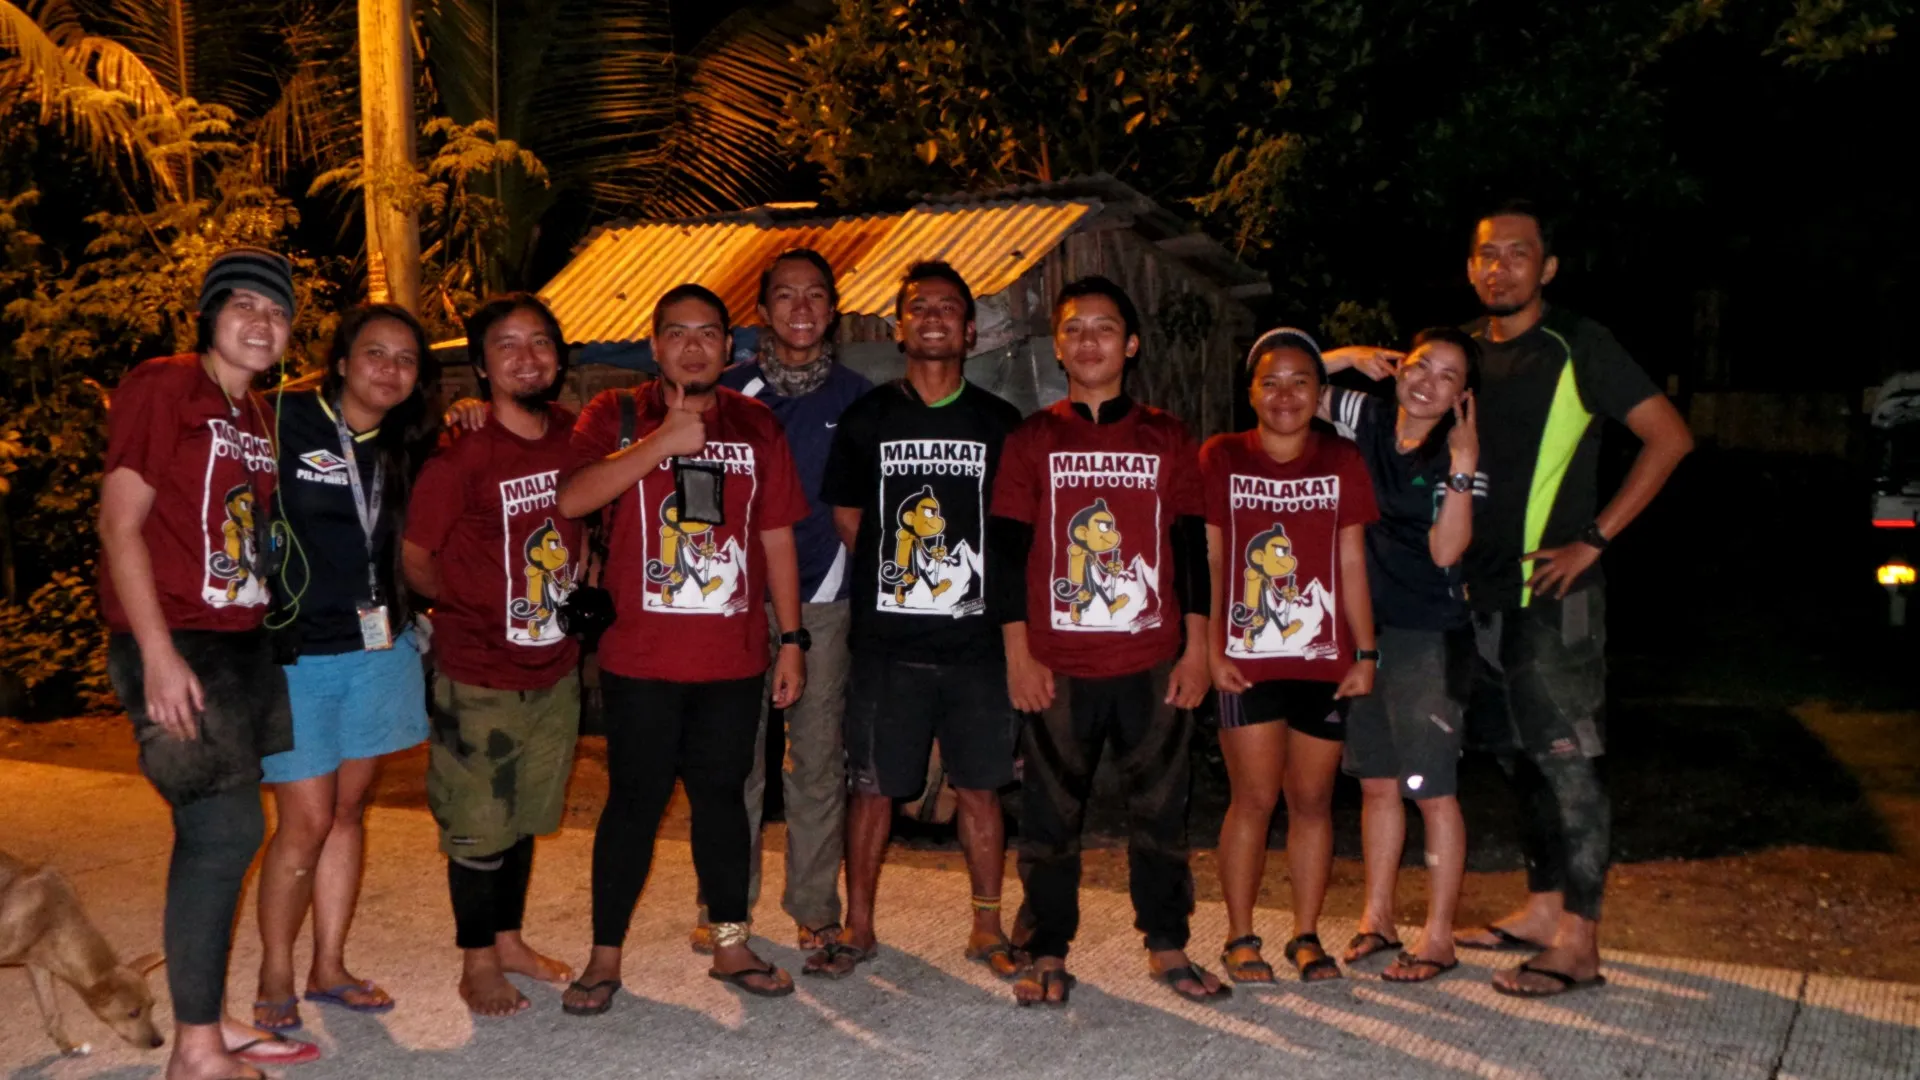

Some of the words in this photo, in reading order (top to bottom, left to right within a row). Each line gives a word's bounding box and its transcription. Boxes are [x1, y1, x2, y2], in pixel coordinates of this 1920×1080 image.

[884, 442, 983, 462] MALAKAT
[884, 462, 982, 478] OUTDOORS
[1053, 455, 1157, 474] MALAKAT
[503, 474, 556, 502] MALA
[1054, 474, 1157, 489] OUTDOORS
[1233, 476, 1336, 499] MALAKAT
[1233, 497, 1336, 513] OUTDOORS
